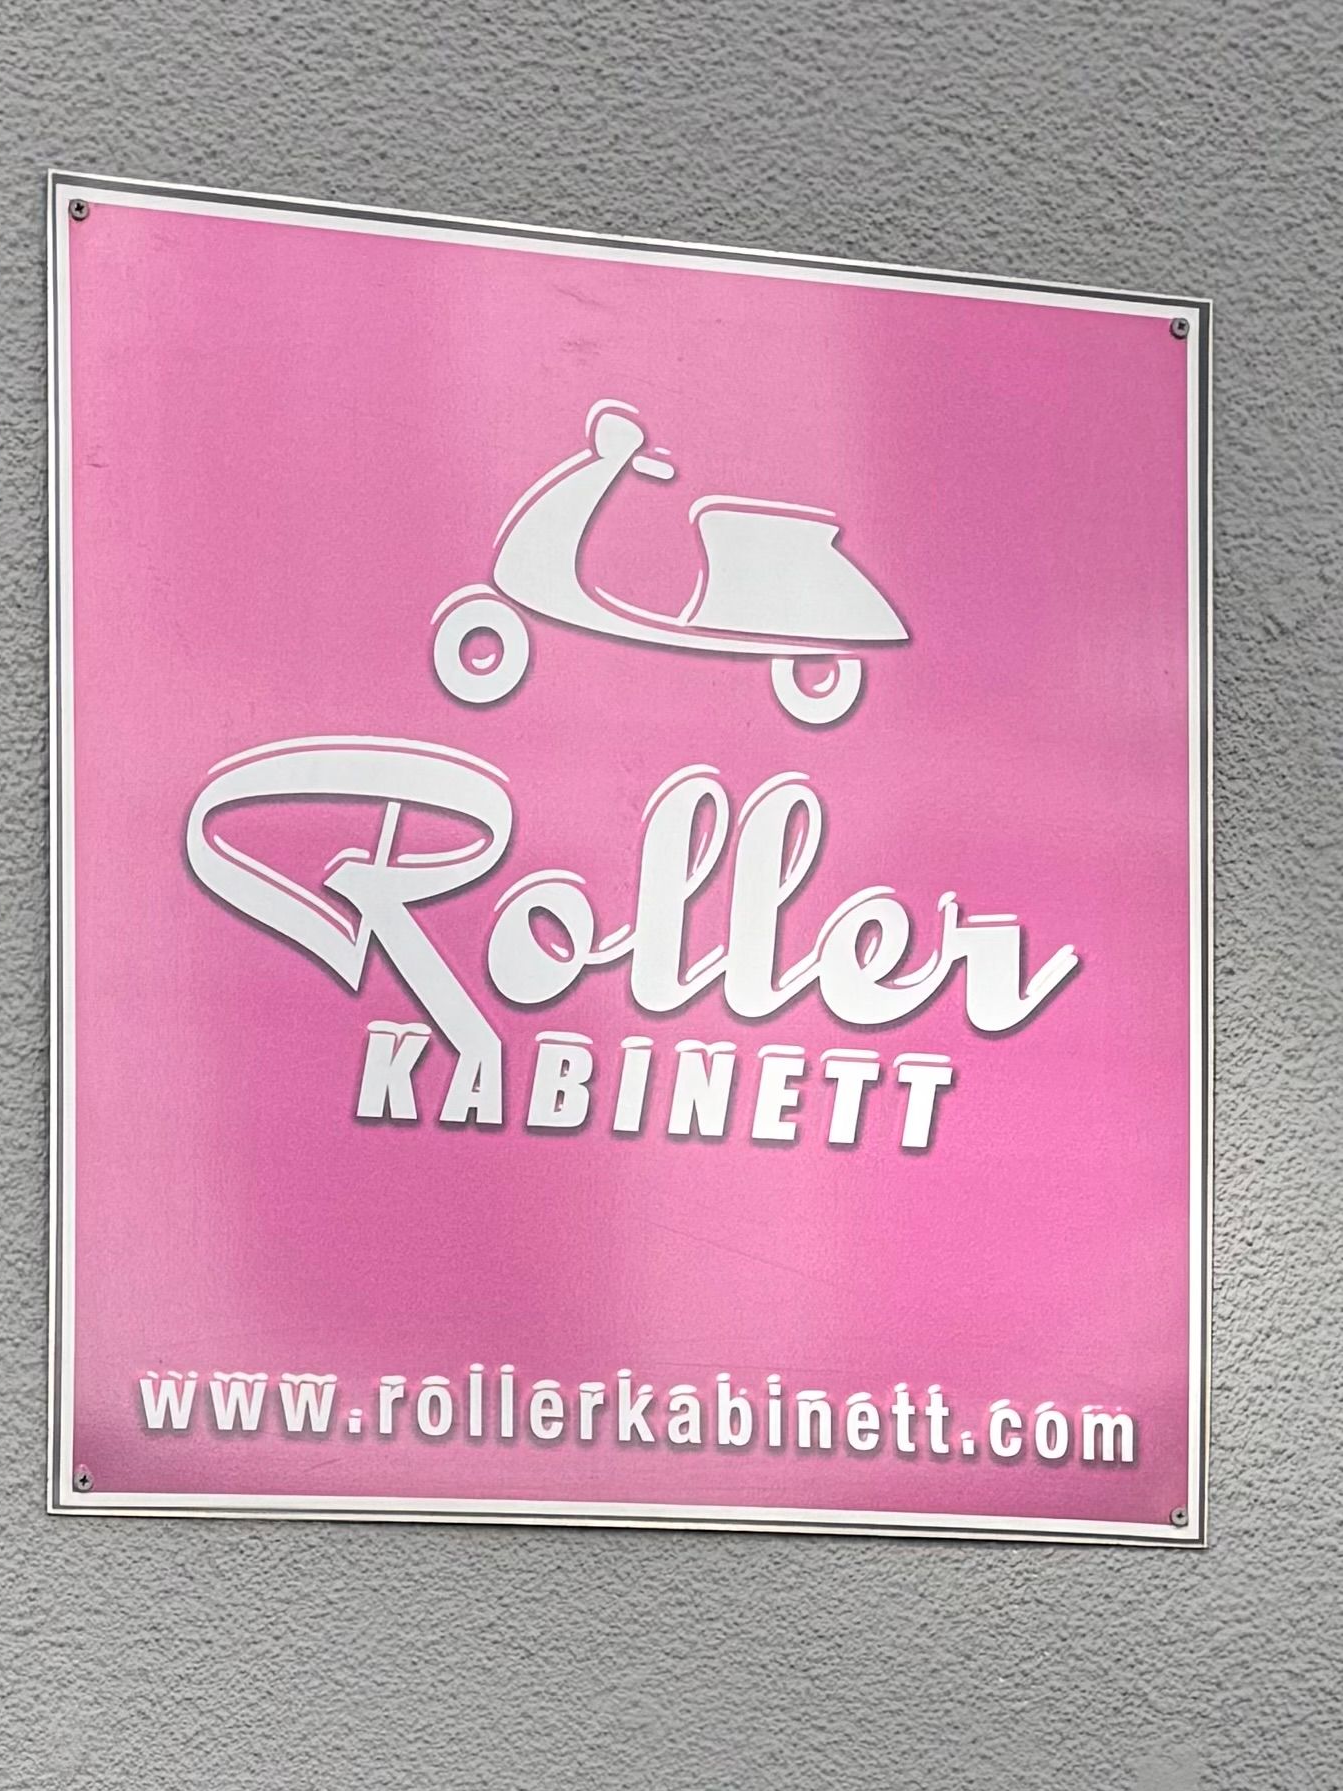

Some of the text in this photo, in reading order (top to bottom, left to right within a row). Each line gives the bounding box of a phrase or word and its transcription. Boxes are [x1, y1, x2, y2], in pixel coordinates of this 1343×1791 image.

[184, 735, 1079, 1050] Roller
[355, 1021, 953, 1149] KABINETT
[137, 1362, 1136, 1464] www.rollerkabinett.com
